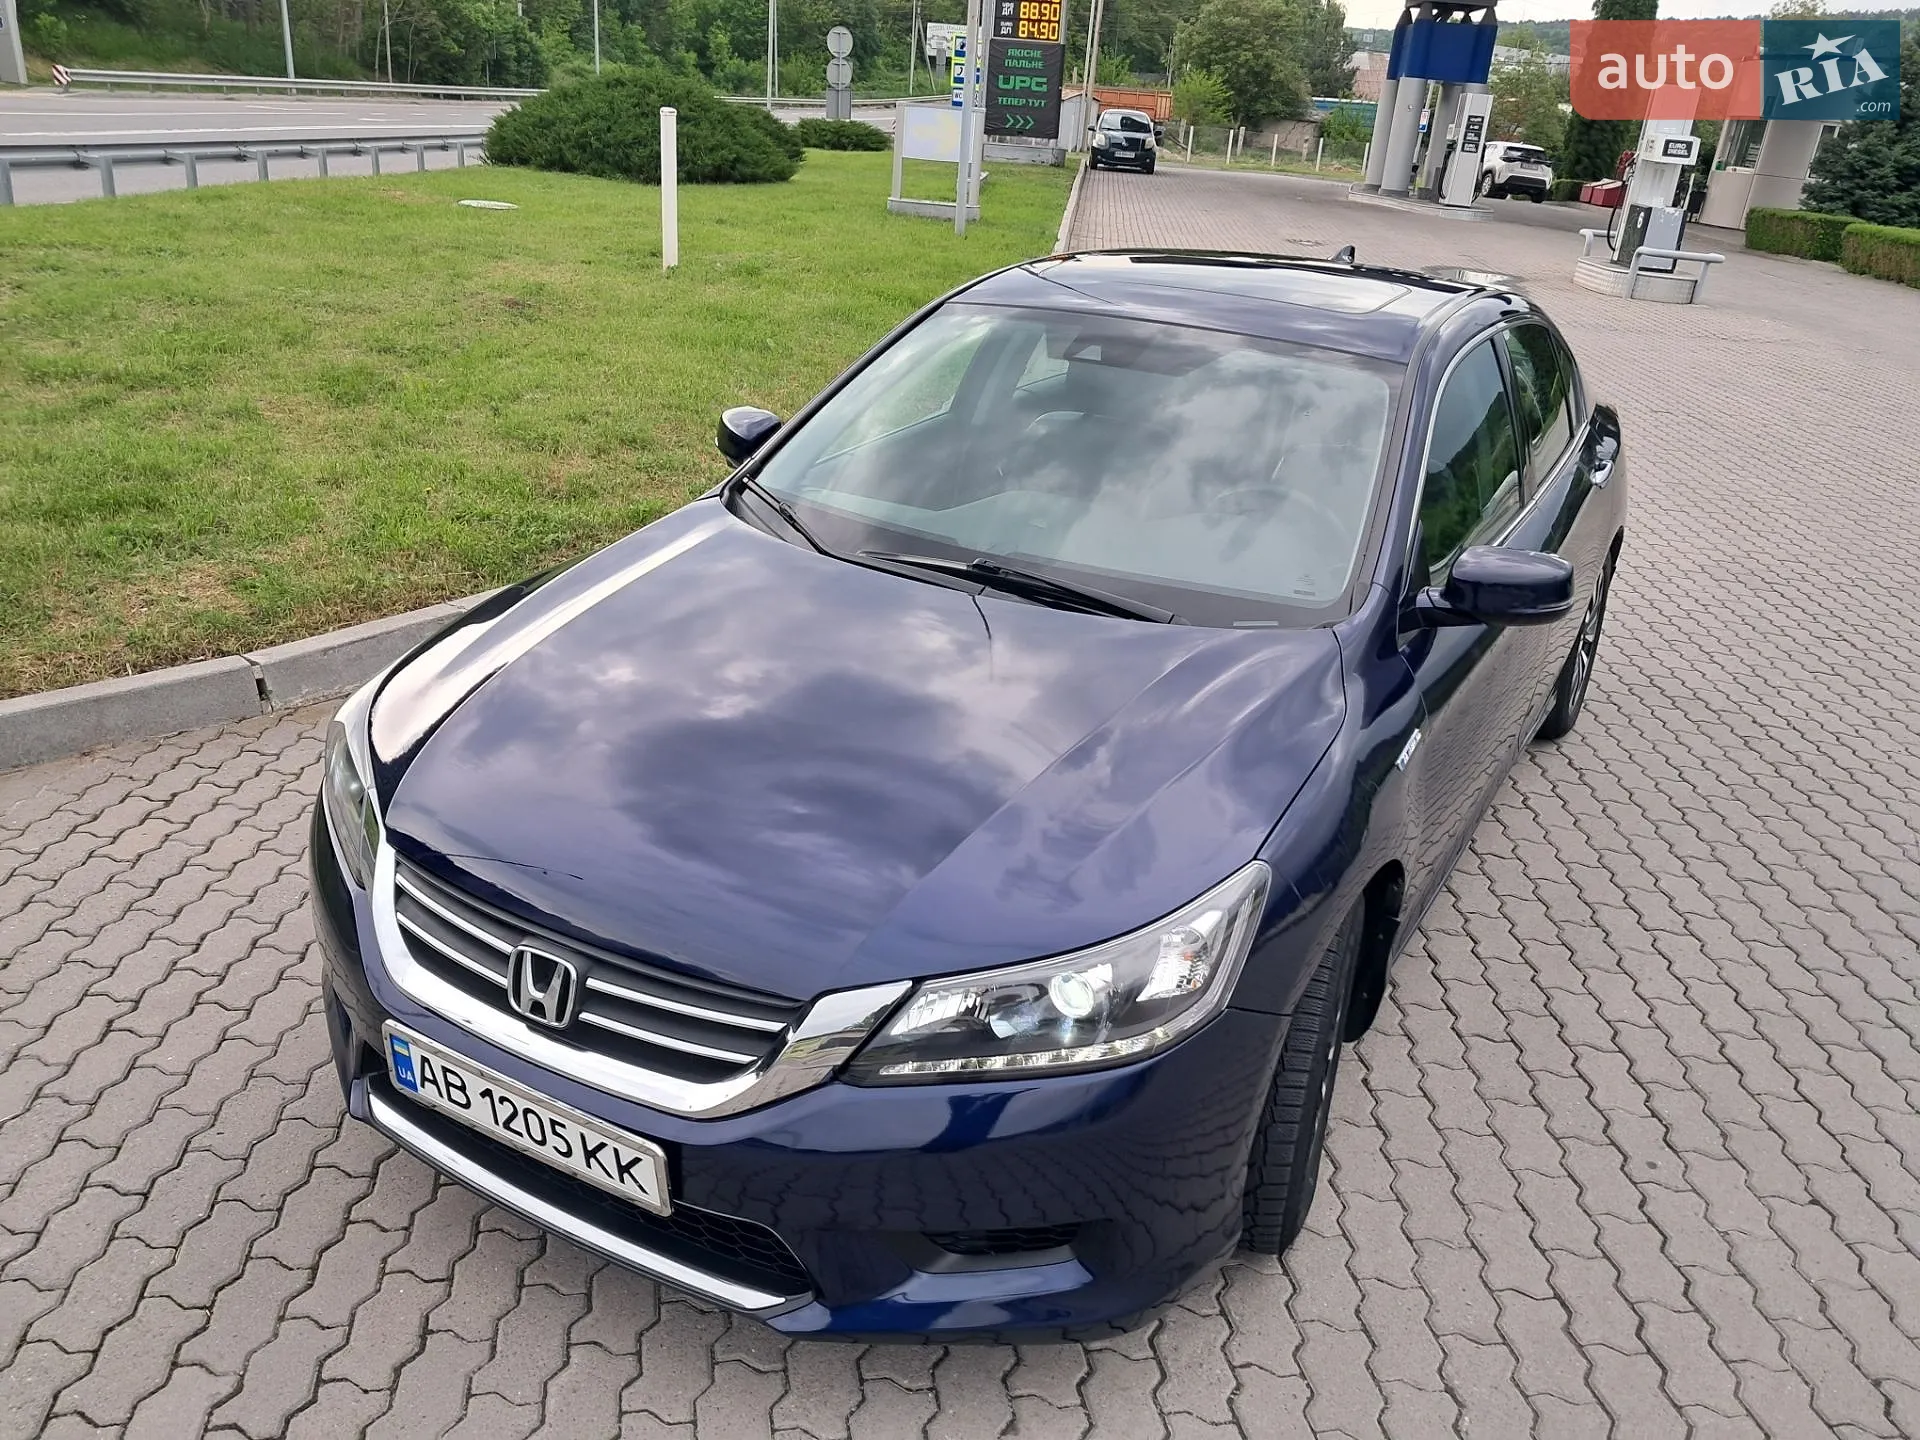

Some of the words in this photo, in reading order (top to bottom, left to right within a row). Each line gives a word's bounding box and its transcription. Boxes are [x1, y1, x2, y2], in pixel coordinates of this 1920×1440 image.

[1020, 2, 1060, 20] 88.90
[1018, 20, 1059, 40] 84.90
[1007, 48, 1043, 58] ЯКІСНЕ
[1004, 58, 1045, 69] ПАЛЬНЕ
[998, 74, 1048, 92] UPG
[998, 96, 1026, 106] ТЕПЕР
[1028, 98, 1047, 107] ТУТ
[1667, 148, 1689, 156] DIESEL
[1668, 142, 1687, 150] EURO
[1636, 211, 1645, 229] 6
[398, 1066, 415, 1082] UA
[420, 1054, 472, 1110] AB
[479, 1087, 573, 1158] 1205
[579, 1130, 649, 1195] KK
